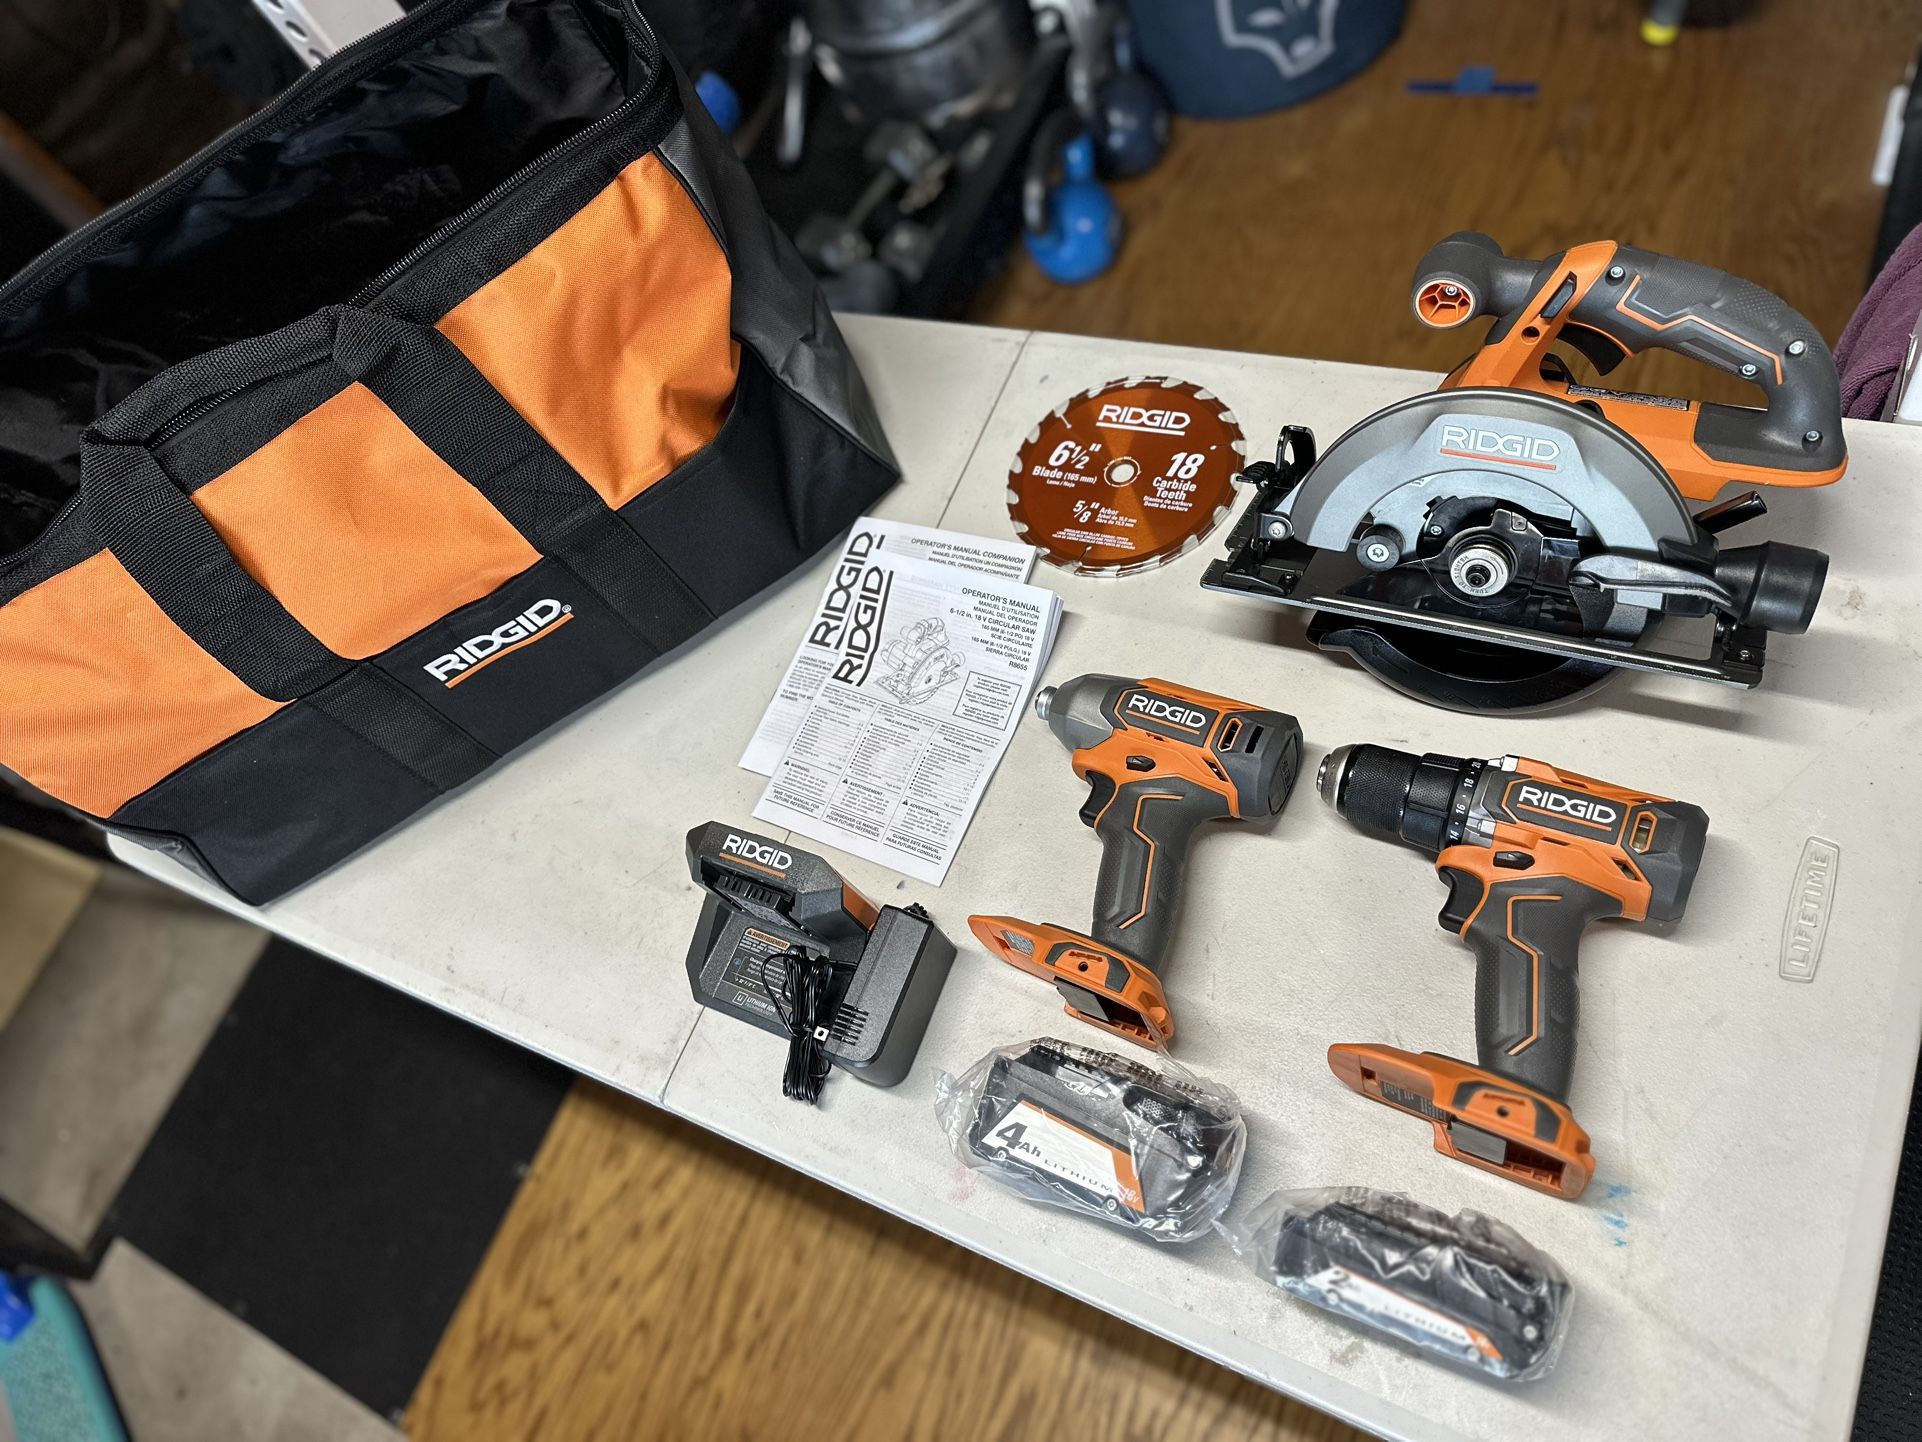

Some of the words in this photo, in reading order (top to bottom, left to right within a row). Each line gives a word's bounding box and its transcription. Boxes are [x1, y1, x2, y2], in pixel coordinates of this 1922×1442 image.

[1098, 404, 1190, 430] RIDGID
[1441, 424, 1561, 461] RIDGID
[1032, 466, 1063, 479] Blade
[1064, 472, 1080, 481] (165
[1080, 476, 1098, 484] mm)
[1166, 452, 1205, 479] 18
[1152, 476, 1197, 492] Carbide
[1156, 487, 1186, 500] Teeth
[1100, 507, 1119, 516] Arbor
[911, 538, 952, 550] OPERATOR'S
[953, 546, 981, 556] MANUAL
[982, 551, 1025, 564] COMPANION
[928, 556, 947, 565] MANUAL
[958, 562, 984, 572] OPERADOR
[808, 532, 873, 648] RIDGID
[962, 588, 1007, 604] OPERATOR'S
[1009, 600, 1040, 613] MANUAL
[978, 600, 1000, 610] MANUEL
[1002, 606, 1039, 620] D'UTILISATION
[832, 566, 883, 685] RIDGID
[950, 608, 965, 616] 6-1/2
[988, 618, 1020, 631] CIRCULAR
[973, 606, 995, 616] MANUAL
[1008, 615, 1038, 626] OPERADOR
[423, 599, 561, 681] RIDGID
[1003, 637, 1033, 648] CIRCULAIRE
[986, 647, 1003, 656] SIERRA
[1004, 652, 1030, 662] CIRCULAR
[1009, 661, 1028, 671] R8655
[1128, 694, 1205, 727] RIDGID
[1464, 778, 1474, 788] 18
[774, 794, 790, 804] FUTURE
[790, 800, 814, 813] REFERENCE
[793, 796, 810, 807] MANUAL
[1456, 804, 1466, 815] 16
[1518, 785, 1616, 824] RIDGID
[830, 810, 855, 823] CONSERVER
[863, 822, 880, 832] MANUEL
[839, 819, 855, 828] FUTURE
[893, 833, 910, 842] GUARDE
[922, 843, 939, 853] MANUAL
[1450, 830, 1459, 840] 14
[722, 834, 792, 869] RIDGID
[897, 841, 916, 851] FUTURAS
[917, 848, 941, 861] CONSULTAS
[1788, 850, 1829, 969] LIFETIME
[752, 931, 788, 948] AVERTISSEMENT
[747, 996, 767, 1008] LITHIUM
[1045, 1159, 1113, 1193] LITHIUM
